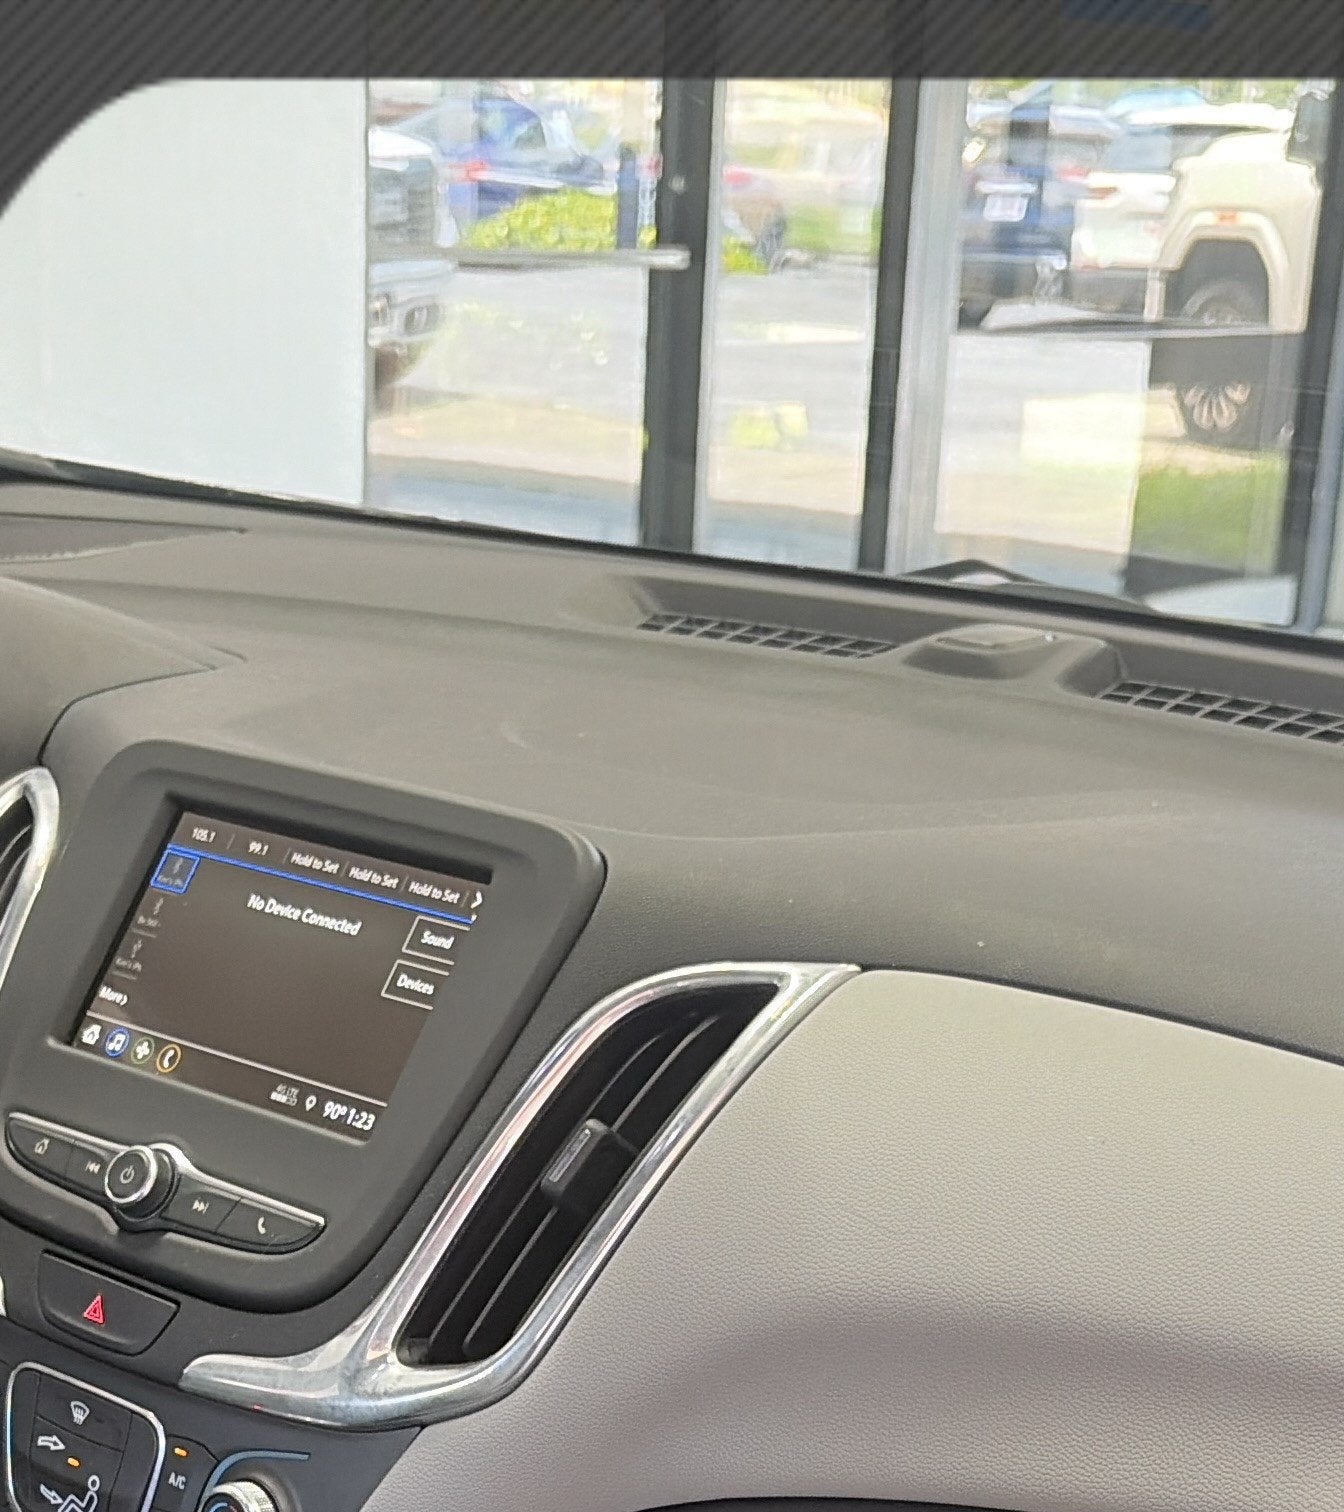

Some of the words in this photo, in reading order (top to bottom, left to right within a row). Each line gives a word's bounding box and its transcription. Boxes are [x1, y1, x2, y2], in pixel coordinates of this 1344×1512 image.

[248, 840, 270, 856] 99.1
[290, 851, 313, 869] Hold
[322, 860, 341, 875] Set
[348, 866, 372, 884] Hold
[381, 874, 400, 889] Set
[408, 881, 432, 898] Hold
[440, 889, 460, 904] Set
[246, 894, 265, 911] No
[265, 898, 301, 922] Device
[301, 908, 363, 936] Connected
[420, 930, 455, 950] Sound
[98, 984, 122, 1004] More
[396, 973, 435, 995] Devices
[346, 1108, 376, 1131] 1:23
[167, 1471, 187, 1490] A/C
